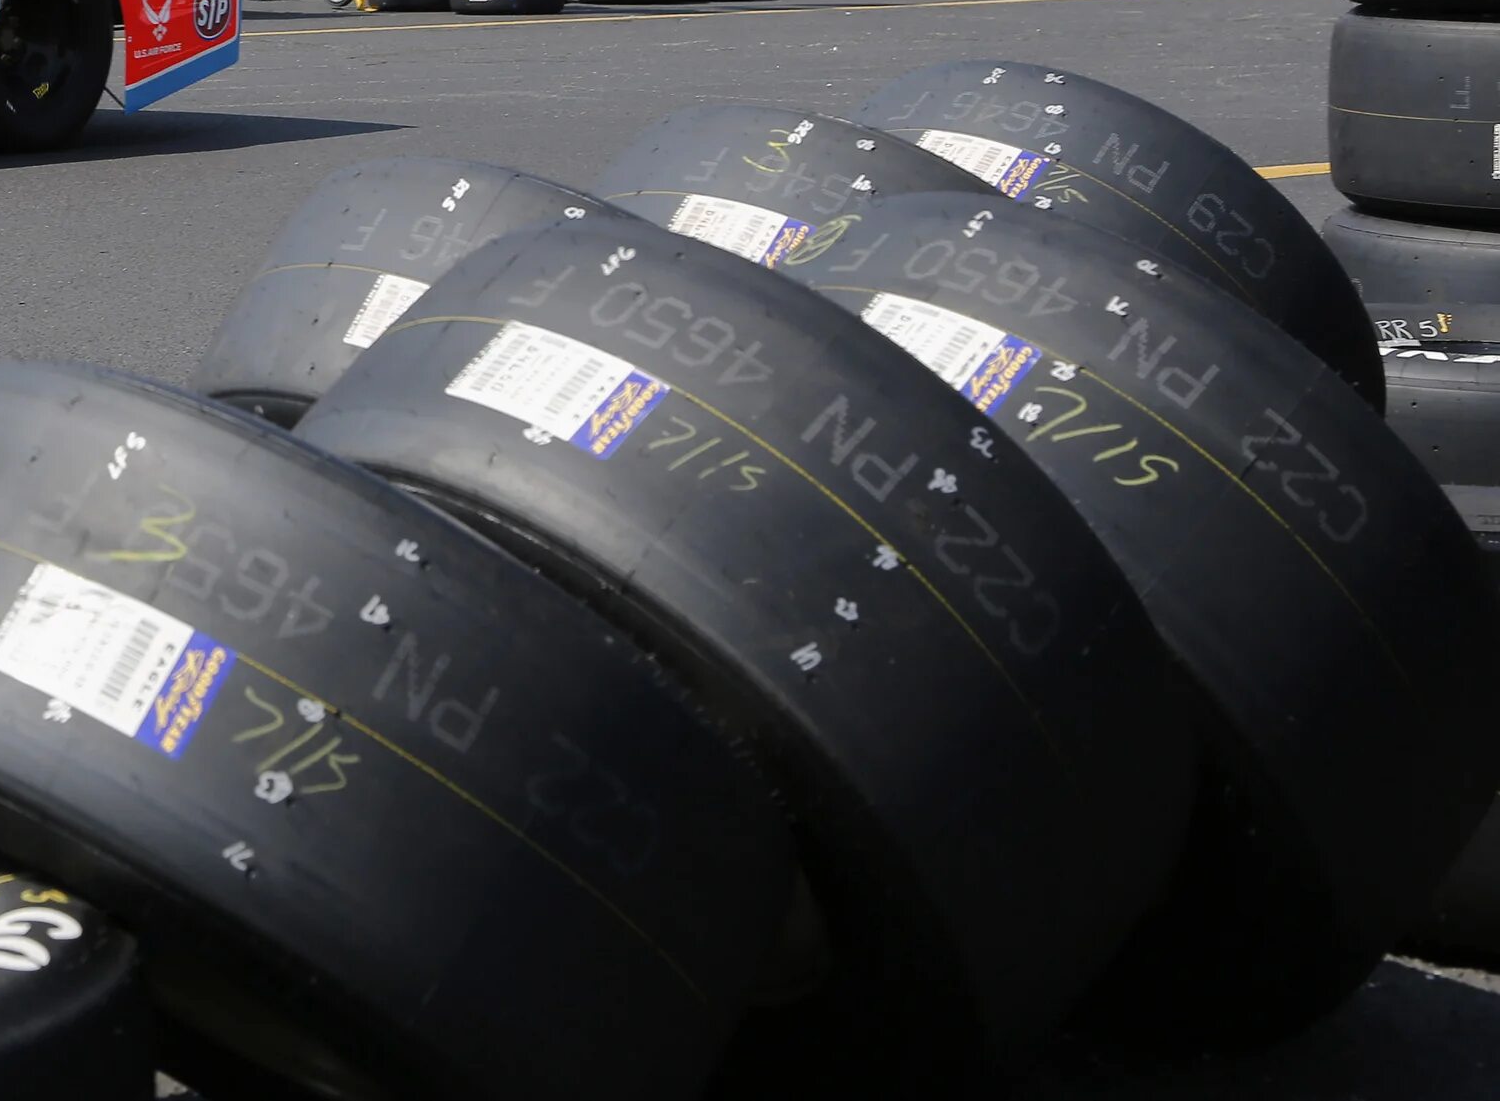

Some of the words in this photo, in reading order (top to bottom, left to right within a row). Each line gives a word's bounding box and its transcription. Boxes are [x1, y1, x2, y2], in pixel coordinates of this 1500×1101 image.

[161, 42, 183, 54] FORCE
[886, 91, 932, 124] F
[684, 146, 732, 185] F
[1090, 133, 1171, 195] PN
[341, 208, 387, 252] F
[827, 231, 890, 274] F
[1186, 192, 1276, 280] C29
[507, 263, 575, 310] F
[902, 238, 1082, 322] 4650
[588, 279, 776, 388] 4650
[1105, 317, 1222, 411] PN
[1376, 318, 1413, 341] RR
[1419, 320, 1438, 339] 5
[594, 379, 668, 456] GOODYEAR
[800, 392, 922, 504] PN
[1241, 406, 1370, 545] C22
[932, 500, 1066, 645] C22
[132, 646, 177, 715] EAGLE
[156, 643, 229, 755] GOODYEAR
[373, 631, 503, 754] PN
